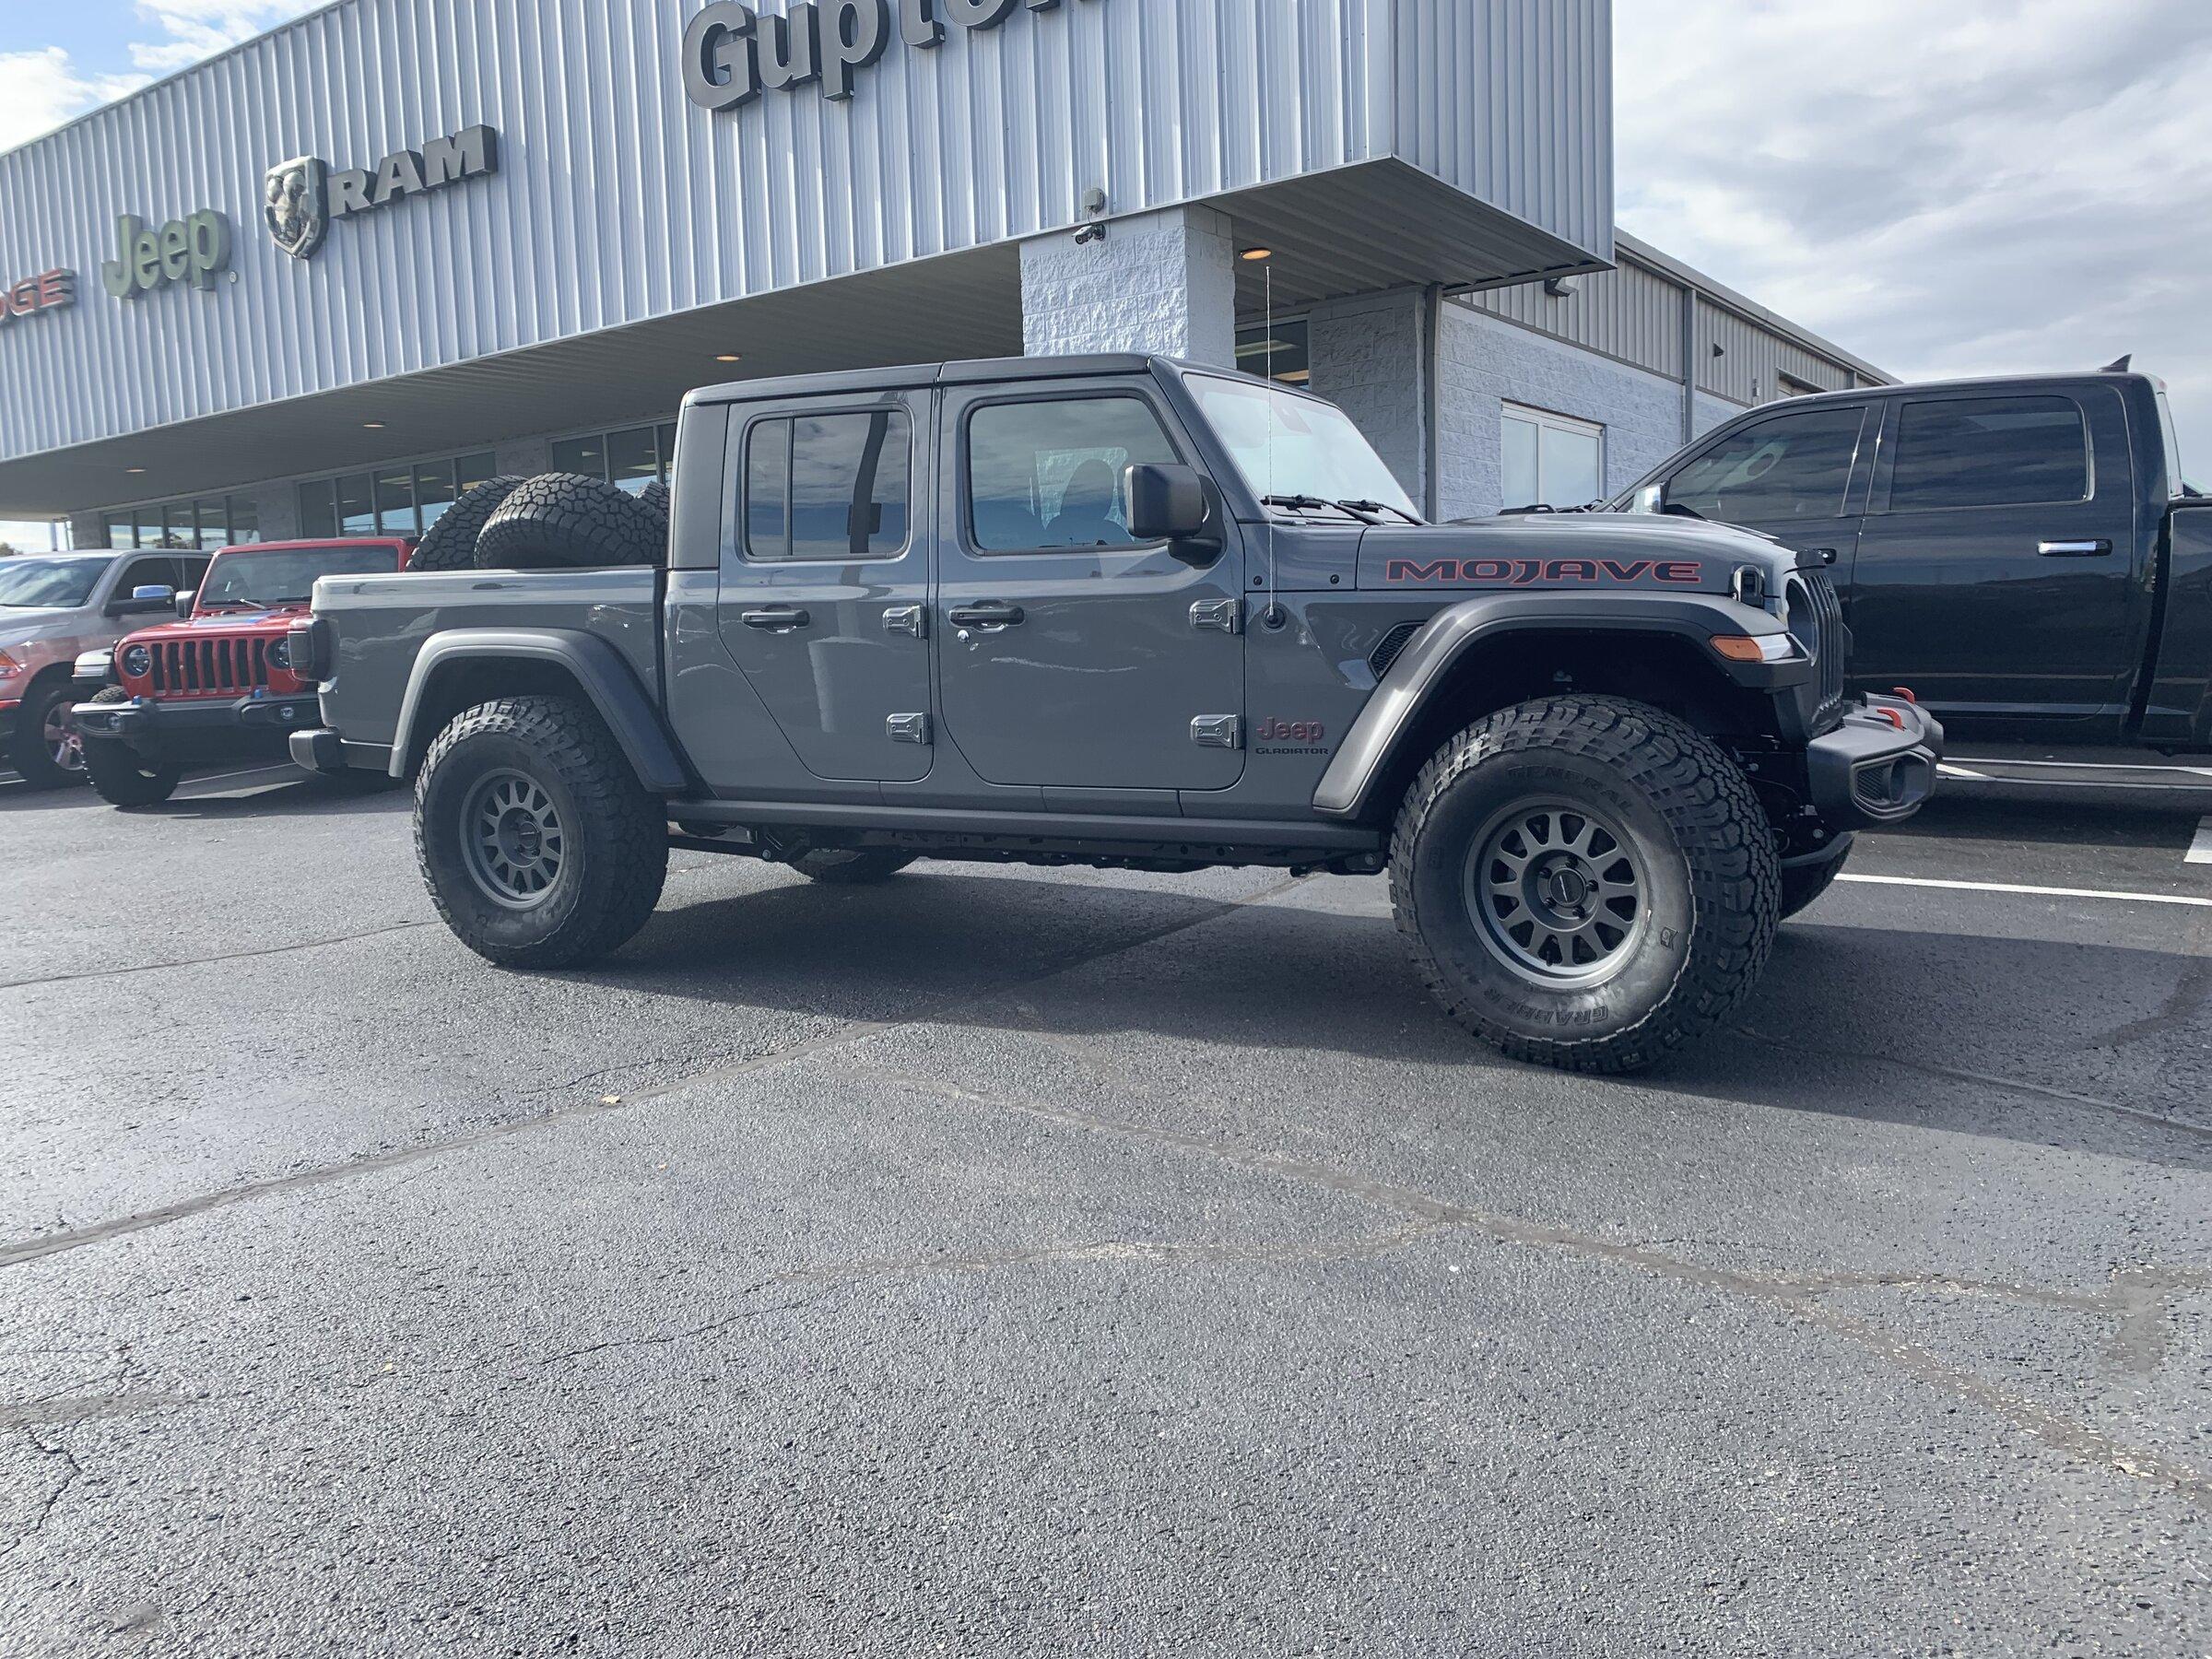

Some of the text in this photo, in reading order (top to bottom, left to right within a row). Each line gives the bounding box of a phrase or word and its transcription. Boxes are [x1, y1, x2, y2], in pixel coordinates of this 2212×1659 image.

[326, 124, 498, 219] RAM
[101, 208, 229, 299] Jeep
[1386, 559, 1701, 584] MOJAVE
[1256, 716, 1324, 745] Jeep
